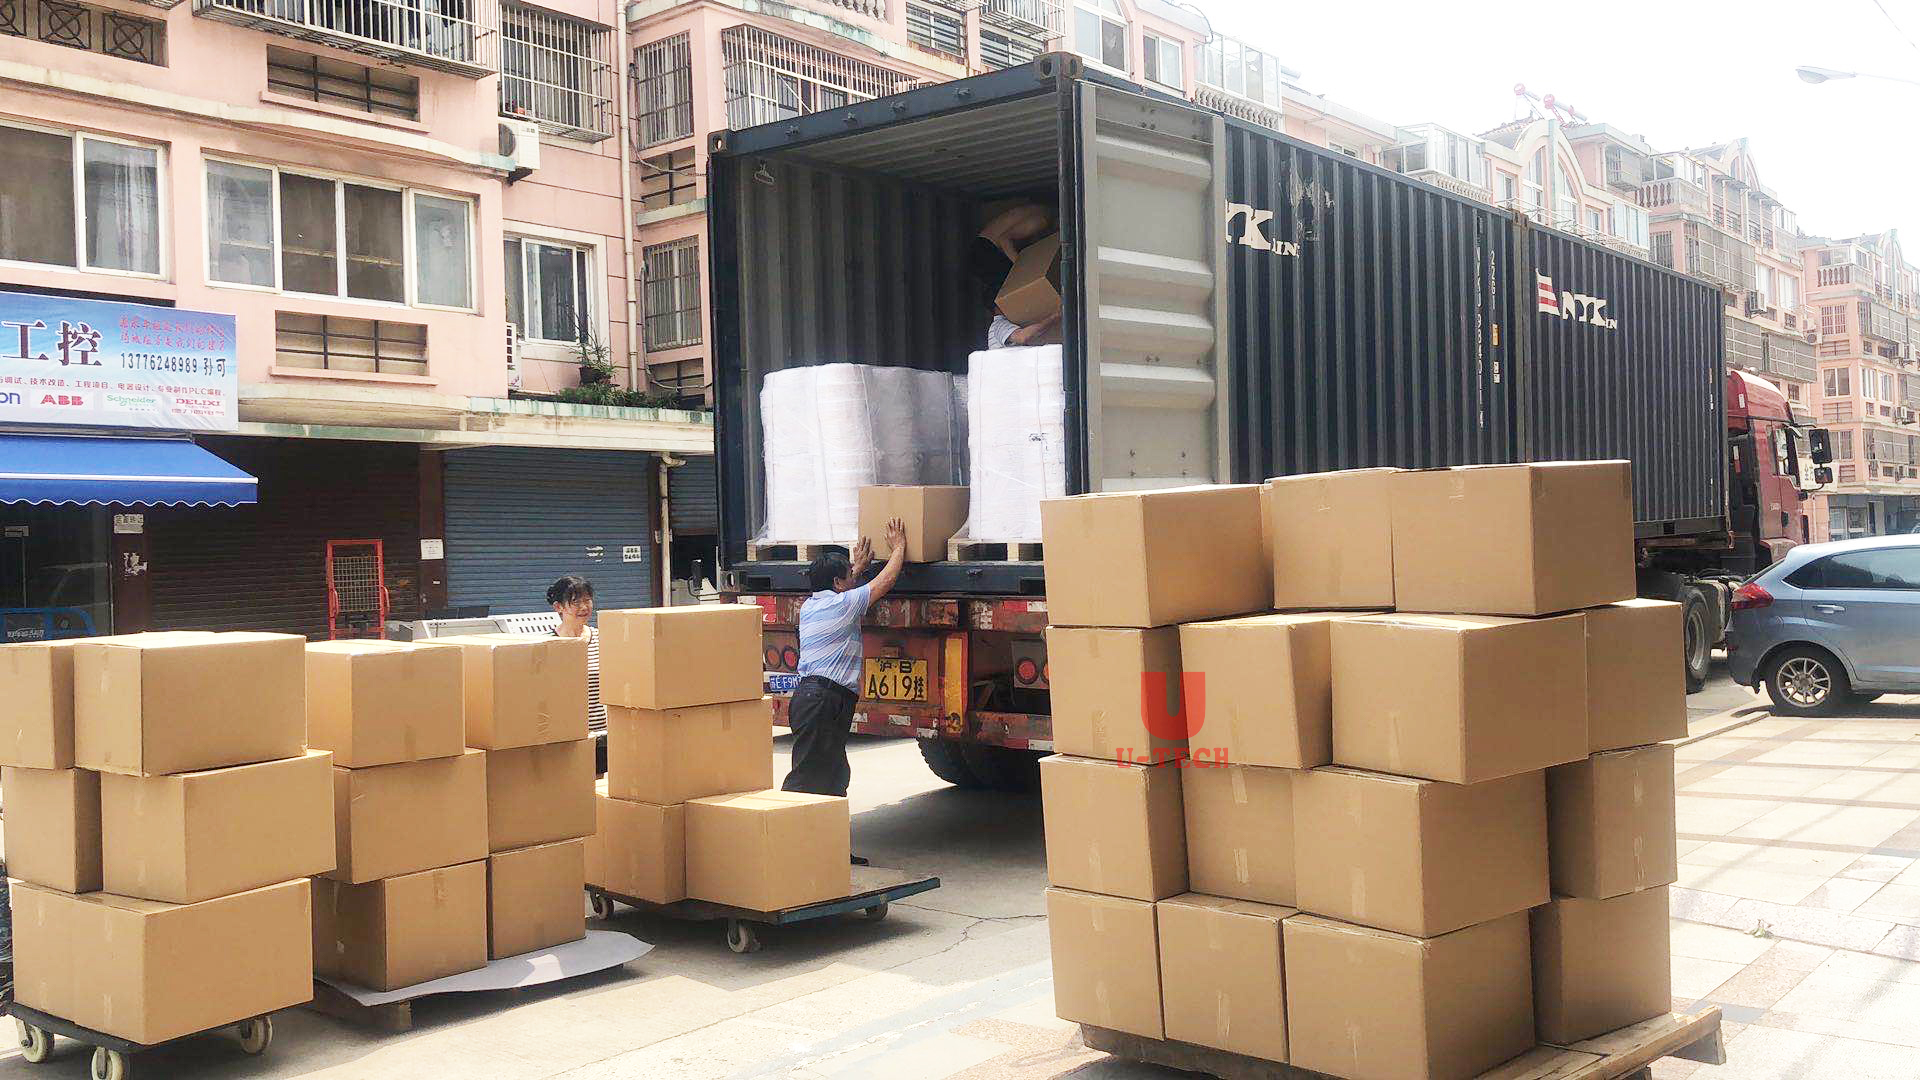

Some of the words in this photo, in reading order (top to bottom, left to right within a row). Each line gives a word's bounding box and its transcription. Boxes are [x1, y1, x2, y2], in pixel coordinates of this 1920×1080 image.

[1562, 291, 1607, 327] NYK
[2, 320, 102, 366] 工控
[120, 352, 197, 373] 13776248989
[40, 394, 84, 406] ABB
[106, 394, 156, 406] Schneider
[175, 398, 222, 407] DELIXI
[868, 674, 924, 699] A619挂
